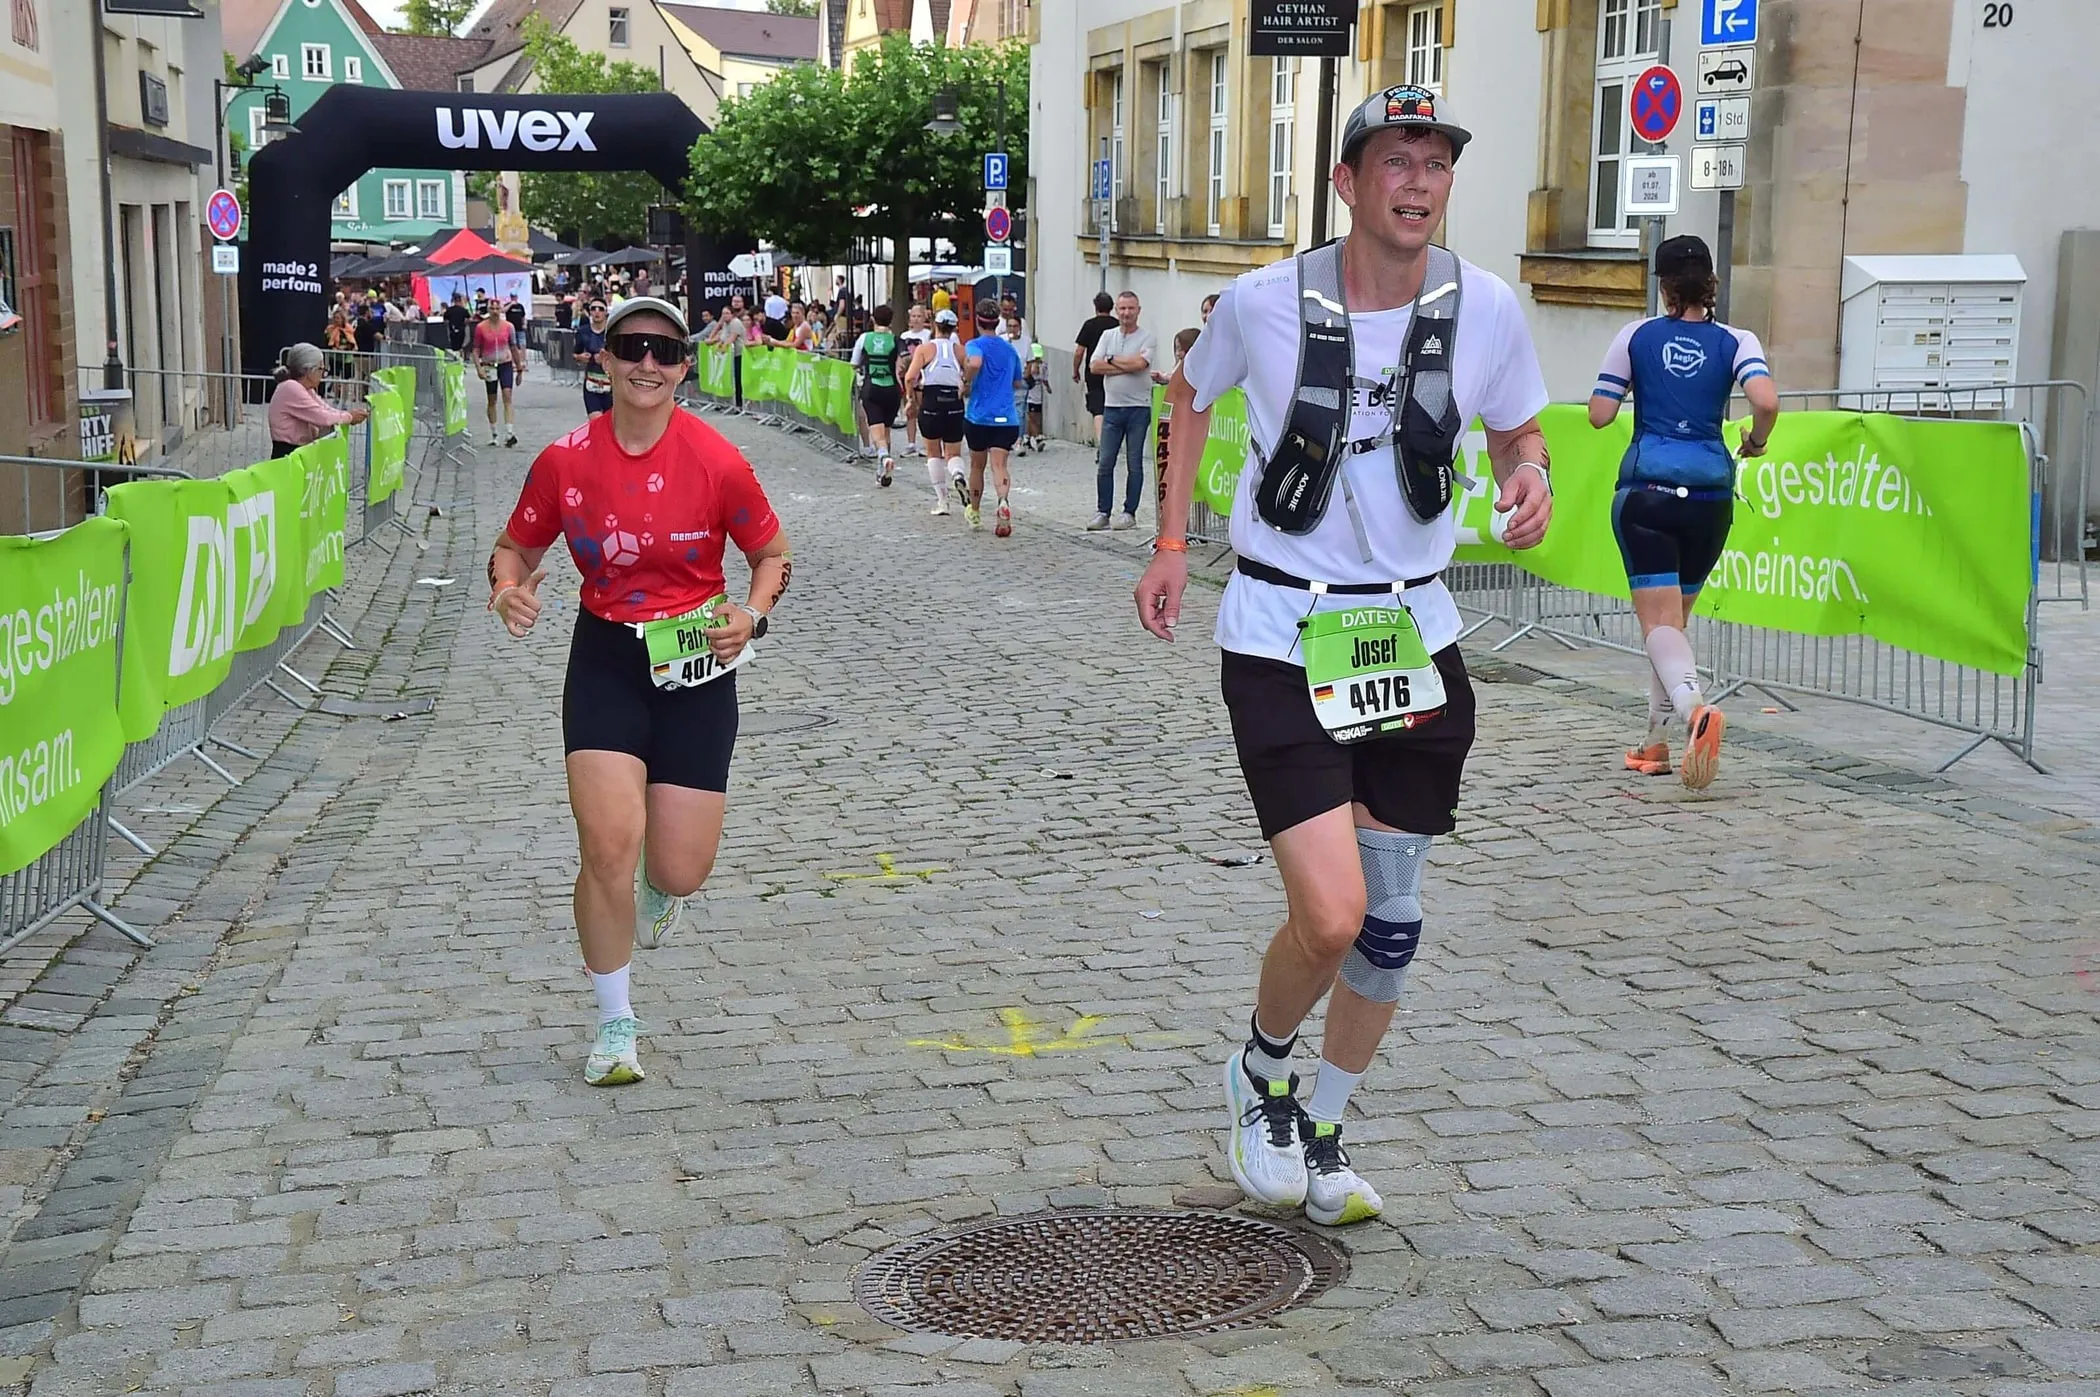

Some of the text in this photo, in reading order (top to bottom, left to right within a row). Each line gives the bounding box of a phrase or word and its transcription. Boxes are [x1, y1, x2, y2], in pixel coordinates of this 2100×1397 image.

[1276, 3, 1326, 14] CEYHAN
[1713, 0, 1742, 35] P
[1983, 3, 2014, 28] 20
[1263, 16, 1339, 26] HAIR ARTIST
[1297, 37, 1323, 45] SALON
[1388, 86, 1432, 97] PEW PEW
[1725, 112, 1745, 126] Std.
[435, 107, 598, 152] uvex
[990, 158, 1003, 185] P
[262, 261, 318, 277] made 2
[262, 276, 322, 294] perform
[1267, 275, 1290, 286] JAKO
[80, 414, 112, 438] RTY
[82, 433, 116, 458] HIFF
[1341, 609, 1400, 628] DATEV
[1350, 633, 1398, 669] Josef
[1349, 675, 1411, 717] 4476
[1333, 726, 1361, 741] HOKA
